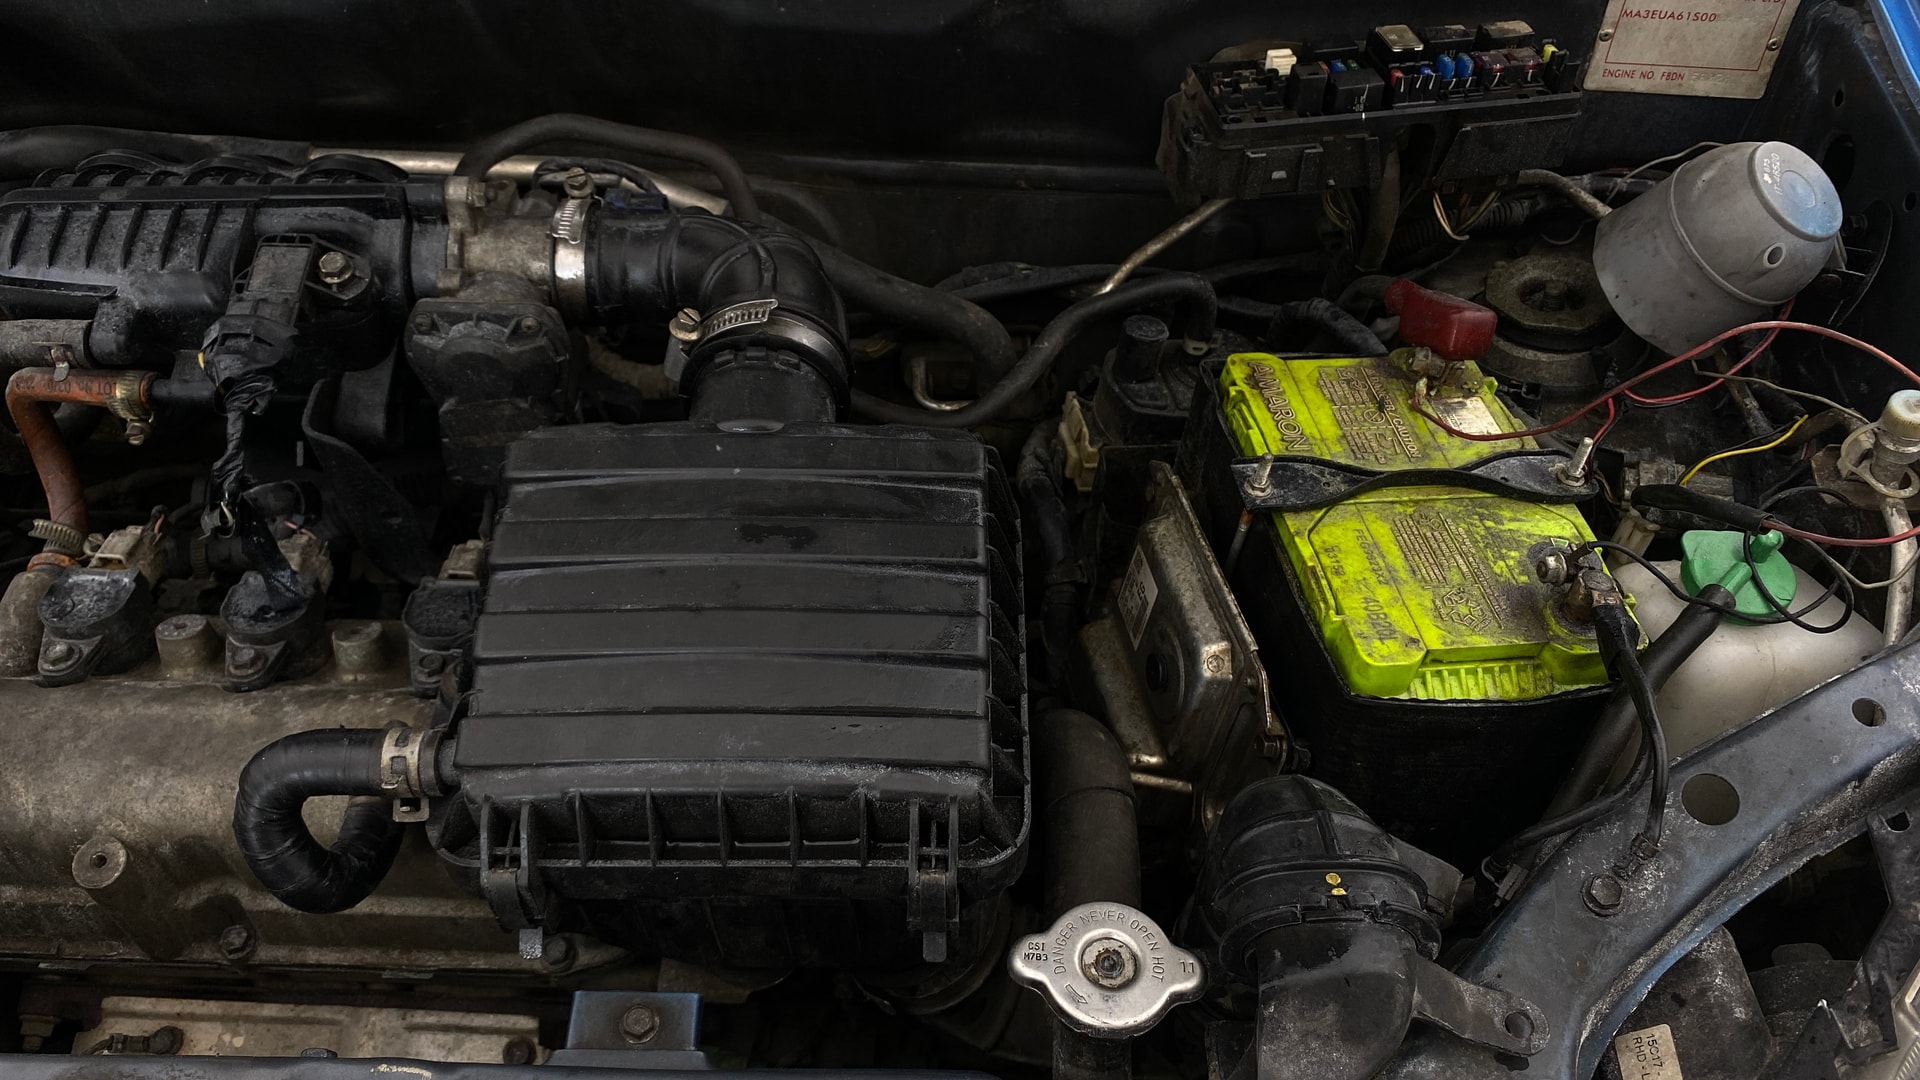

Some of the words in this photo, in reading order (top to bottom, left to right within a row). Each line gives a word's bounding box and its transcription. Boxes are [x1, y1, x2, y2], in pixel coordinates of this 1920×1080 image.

[1602, 68, 1636, 80] ENGINE
[1639, 70, 1656, 81] NO.
[1249, 361, 1311, 452] AMARON
[1393, 418, 1422, 459] CAUTION
[1027, 941, 1046, 952] CSI
[1053, 921, 1079, 975] DANGER
[1079, 909, 1125, 926] NEVER
[1129, 919, 1161, 951] OPEN
[1151, 956, 1166, 983] HOT
